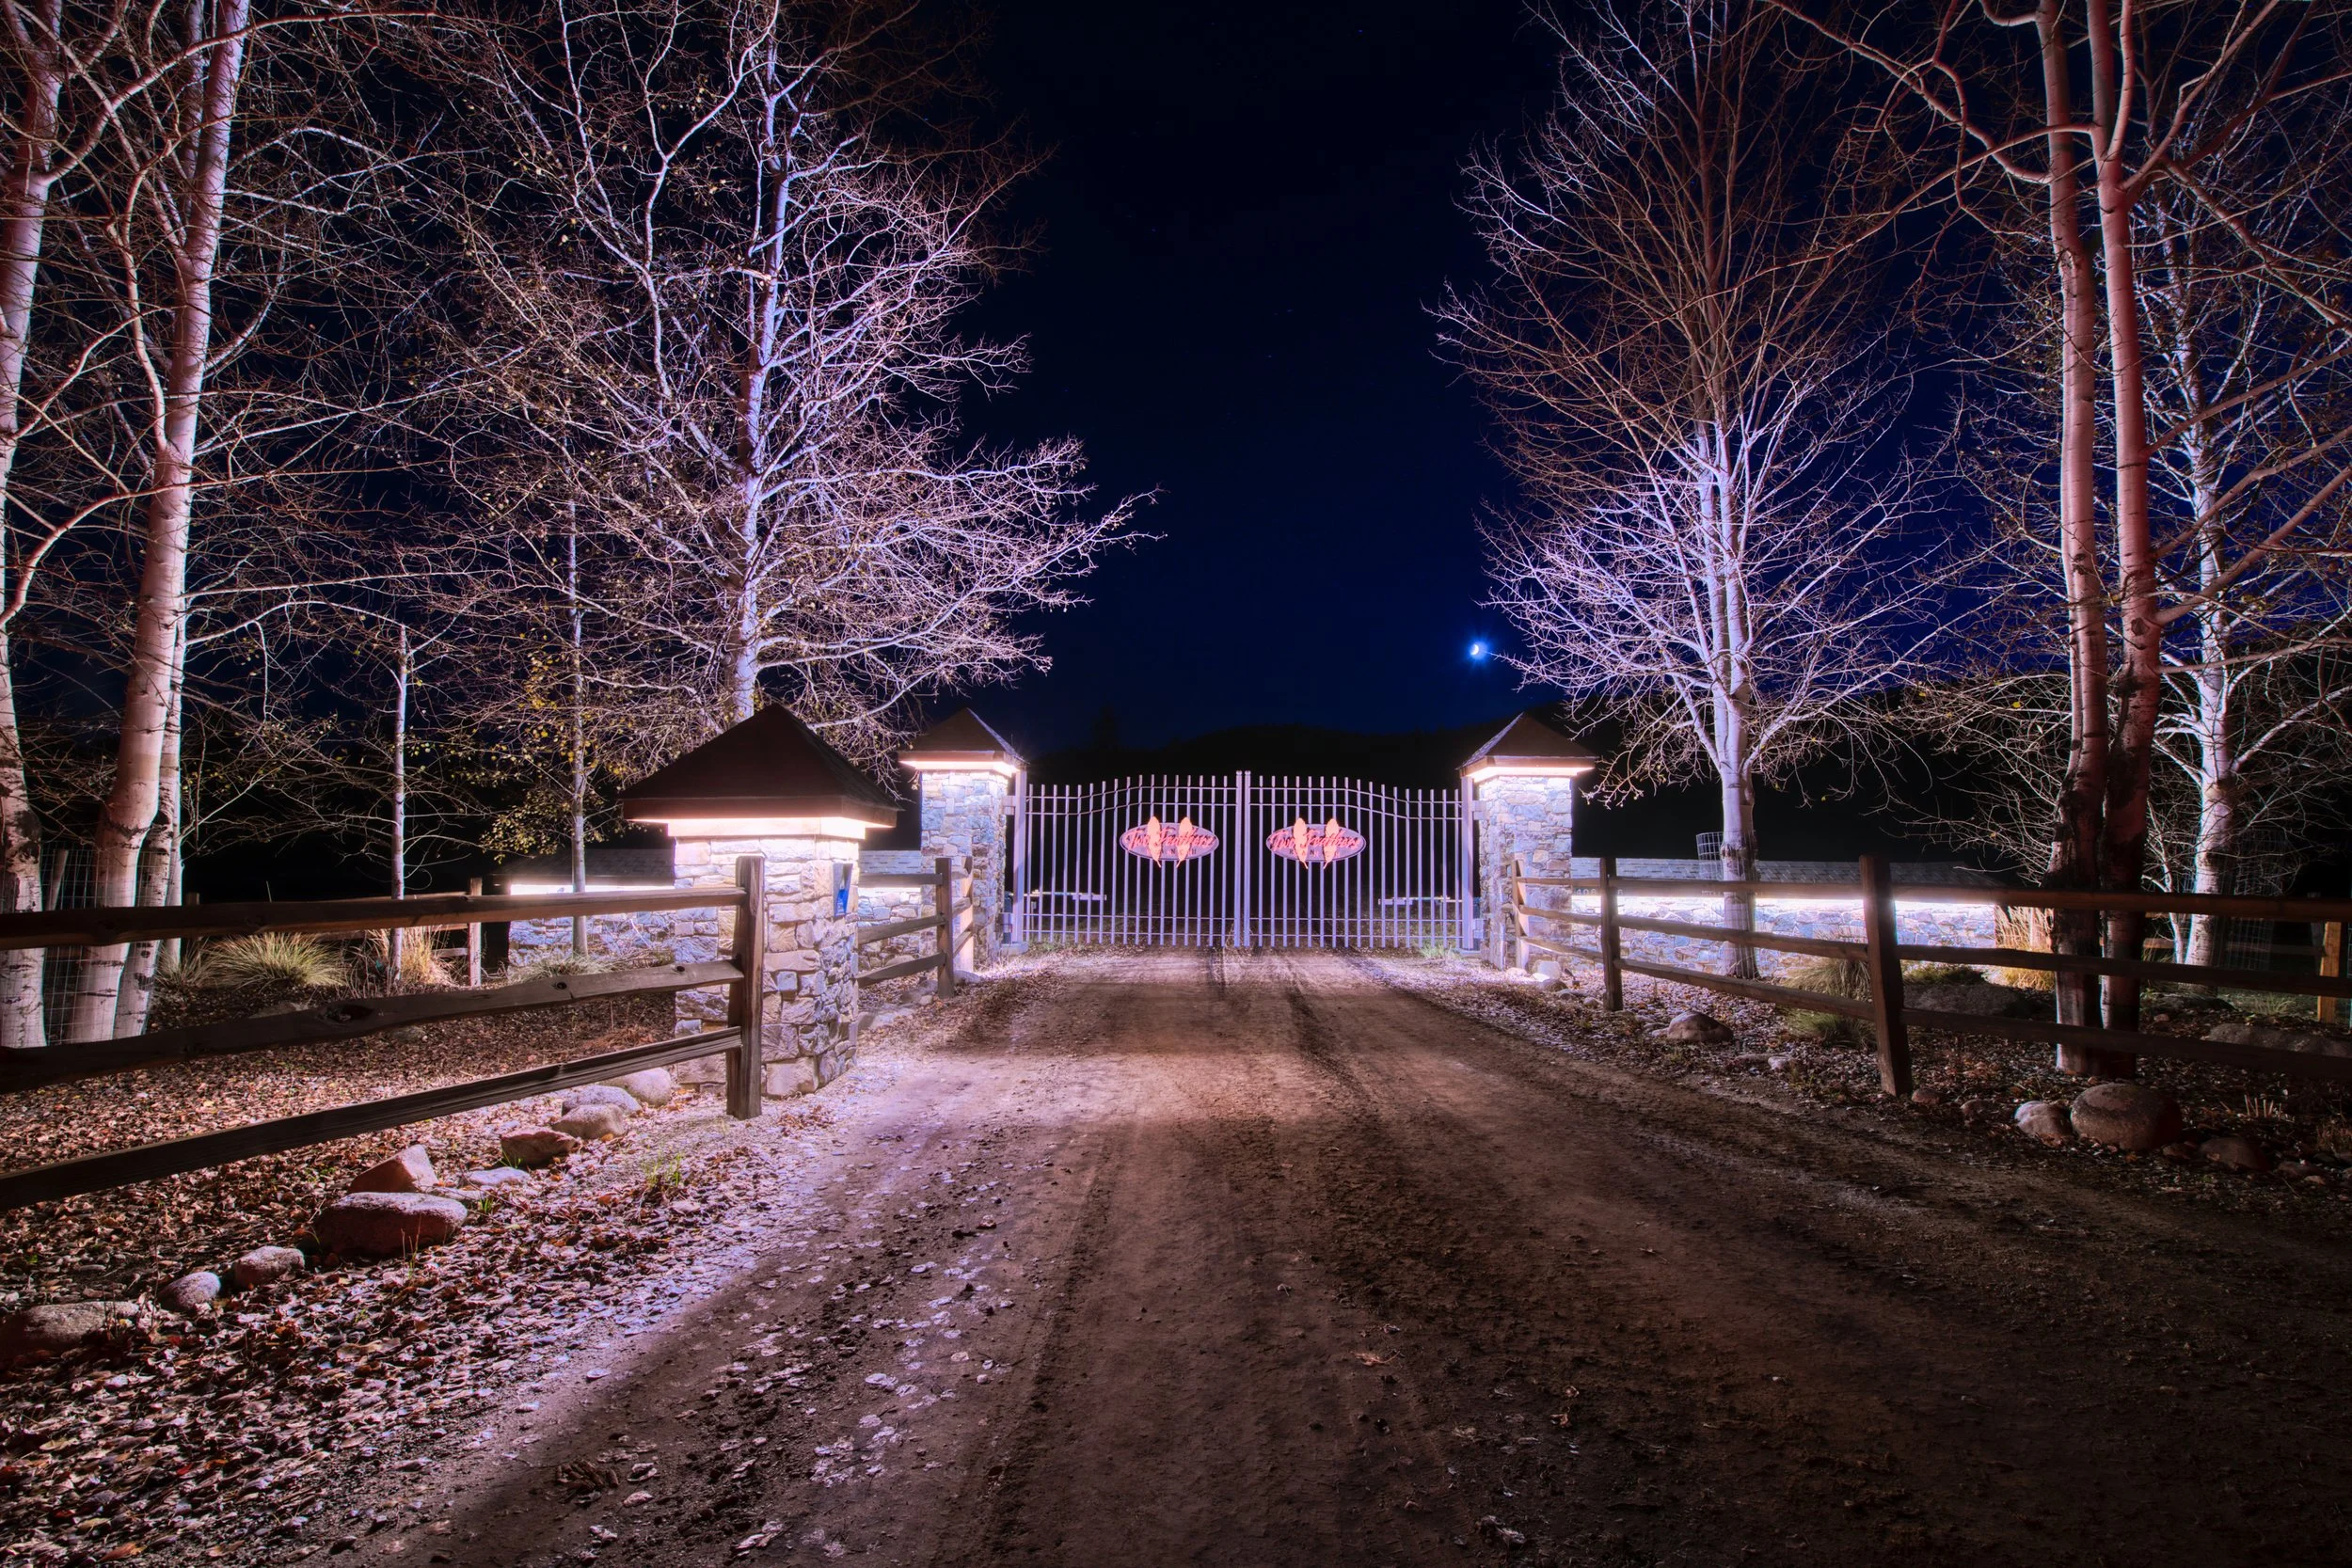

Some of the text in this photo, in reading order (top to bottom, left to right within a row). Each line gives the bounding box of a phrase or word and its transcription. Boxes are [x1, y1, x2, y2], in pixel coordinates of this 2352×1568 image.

[1124, 827, 1216, 848] Two Feathers
[1270, 829, 1361, 851] Two Feathers
